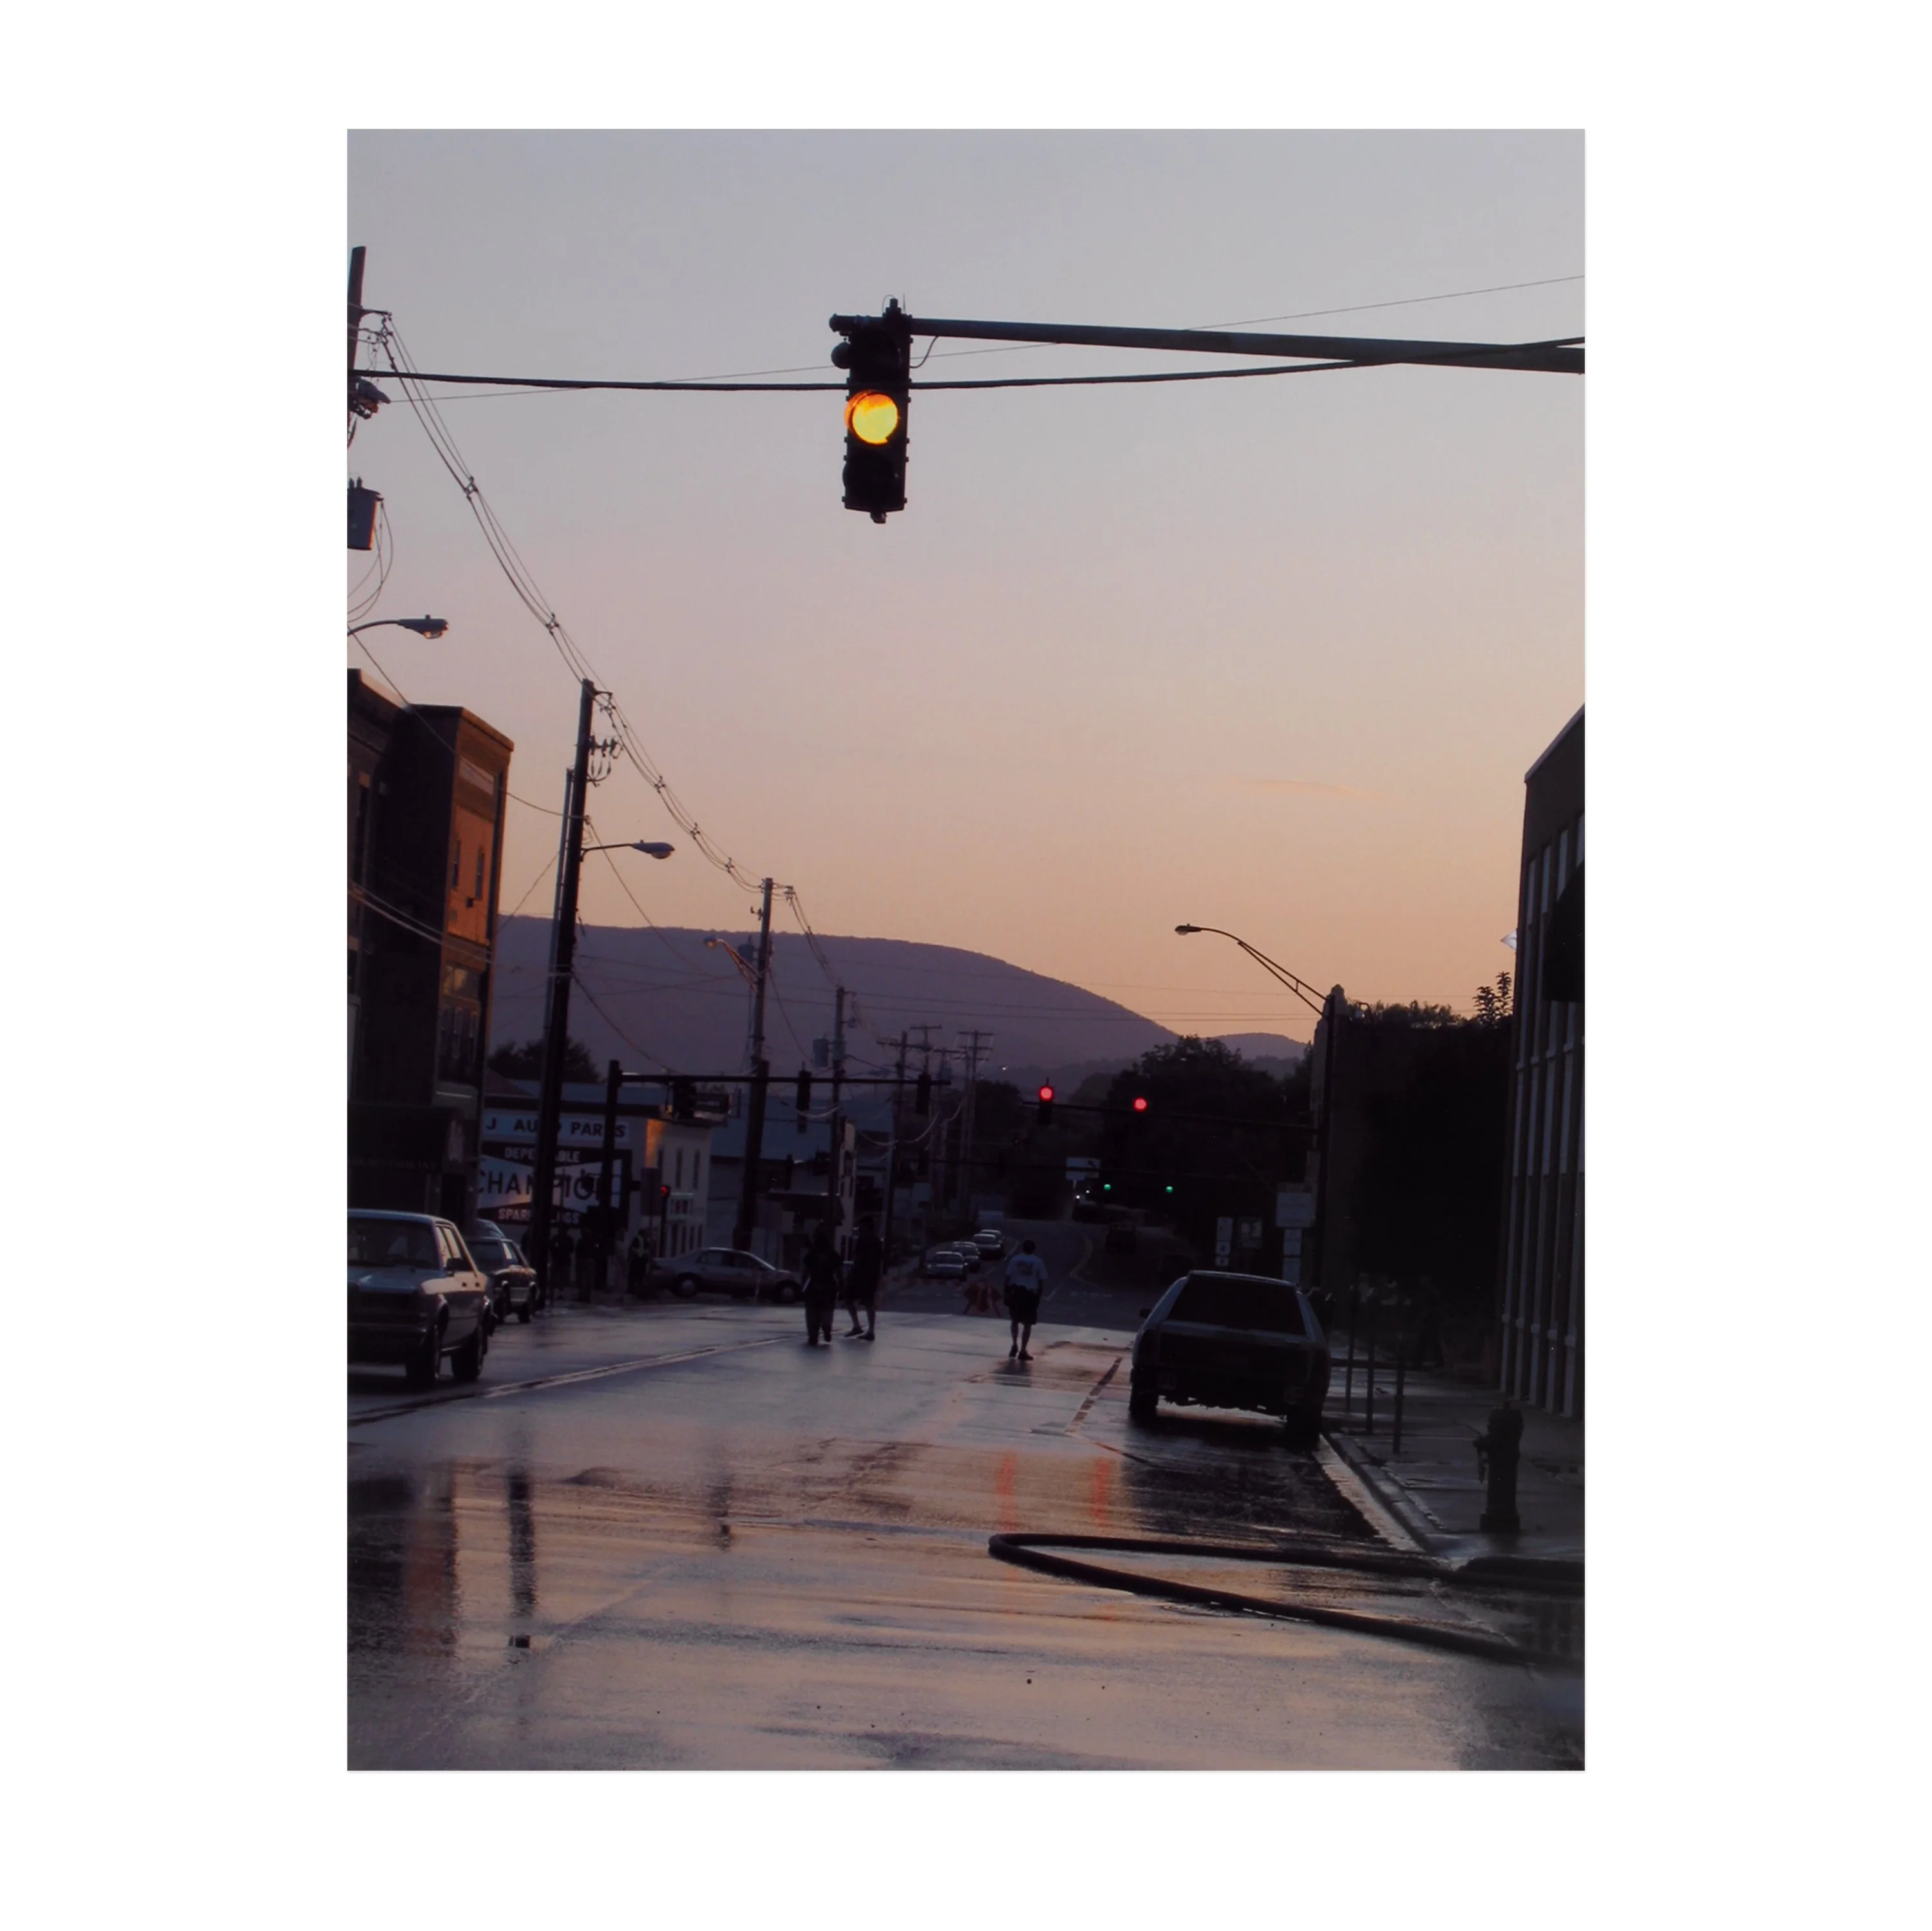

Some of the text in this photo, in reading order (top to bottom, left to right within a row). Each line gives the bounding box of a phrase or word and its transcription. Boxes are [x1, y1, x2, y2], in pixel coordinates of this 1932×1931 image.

[486, 1118, 626, 1138] J AU PARS
[504, 1147, 580, 1162] DEPEBLE
[498, 1208, 532, 1221] SPAR
